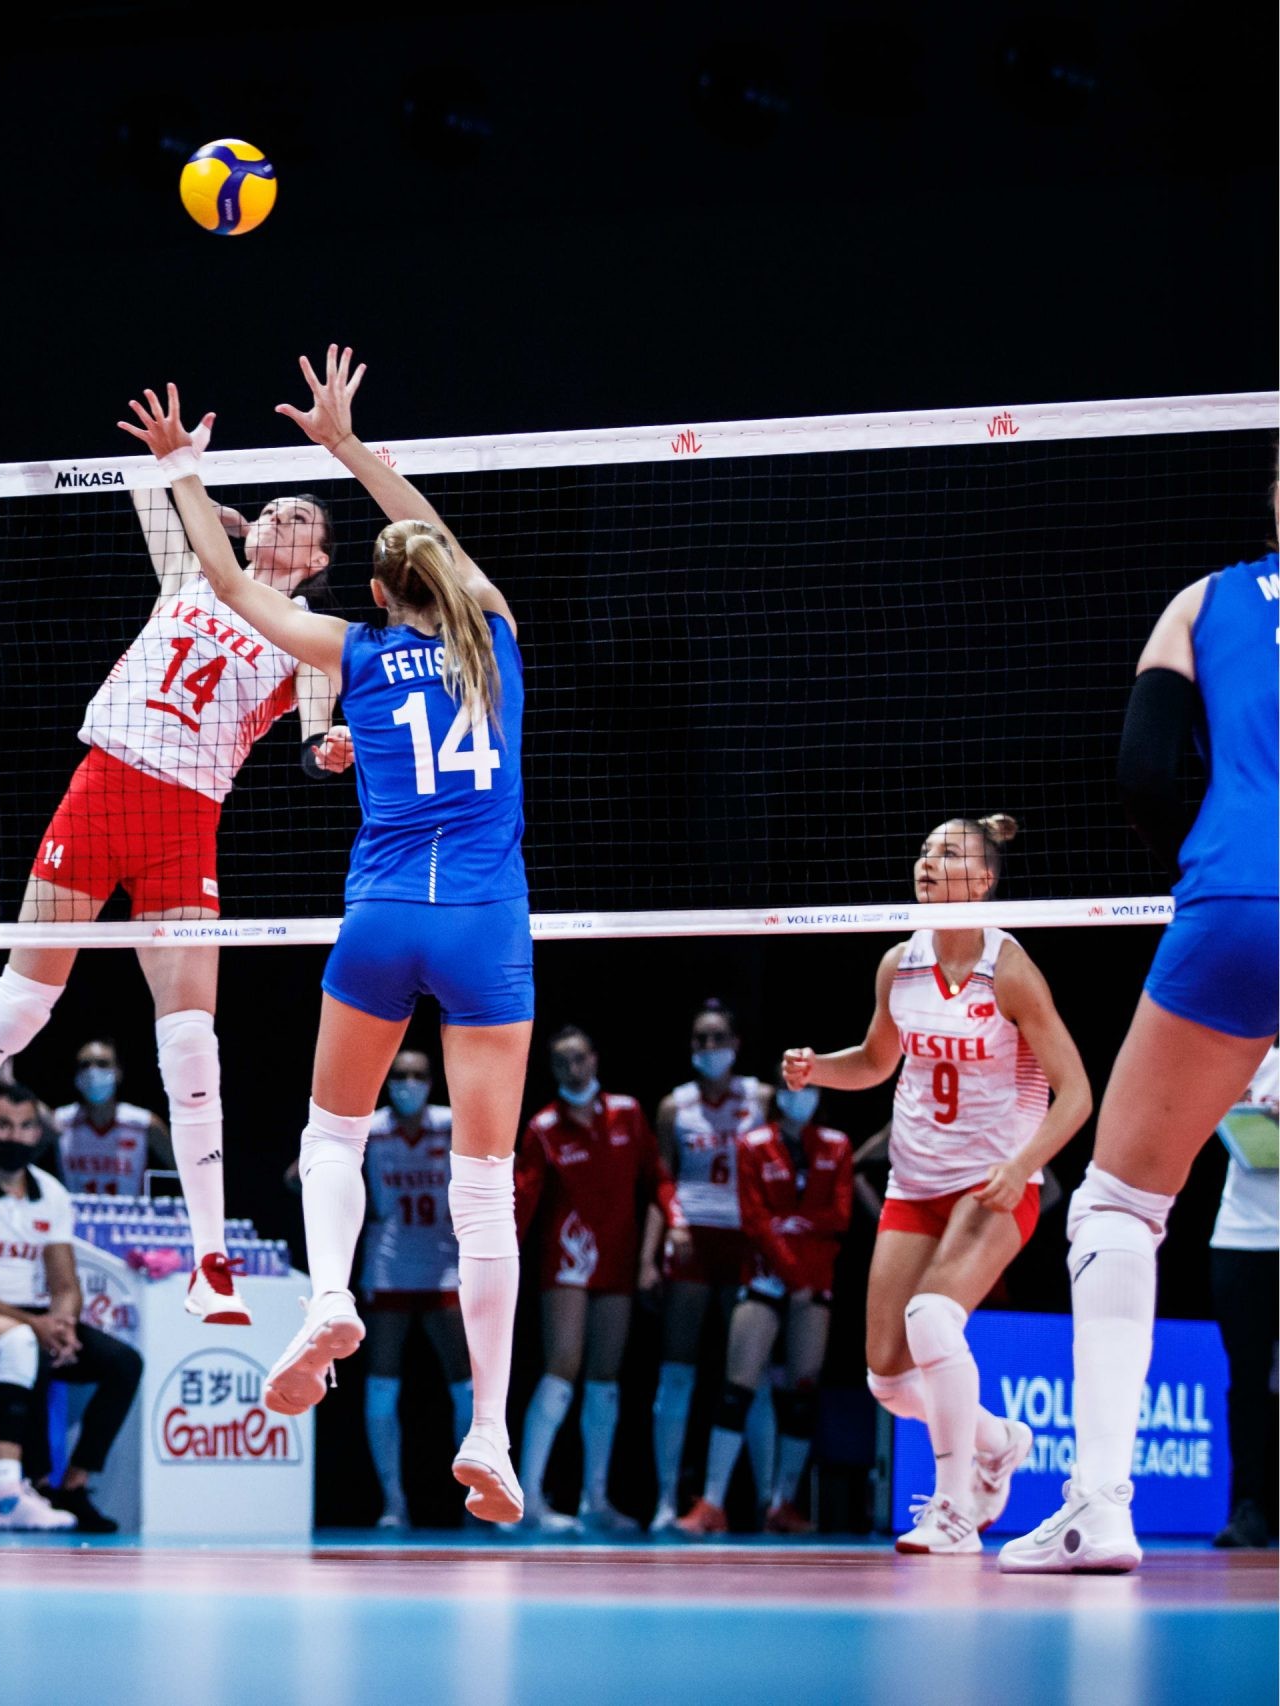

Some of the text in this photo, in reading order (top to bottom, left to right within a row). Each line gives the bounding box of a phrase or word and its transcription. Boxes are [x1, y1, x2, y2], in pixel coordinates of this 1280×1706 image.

[172, 601, 264, 671] VESTEL
[160, 637, 227, 715] 14
[381, 647, 451, 684] FETIS
[392, 690, 501, 795] 14
[44, 840, 64, 869] 14
[787, 914, 859, 924] VOLLEYBALL
[1112, 905, 1174, 916] VOLLEYBA
[173, 928, 240, 937] VOLLEYBALL
[900, 1032, 994, 1062] VESTEL
[933, 1062, 959, 1125] 9
[181, 1369, 260, 1405] 百岁山
[1000, 1376, 1212, 1432] VOLBALL
[1131, 1436, 1211, 1478] EAGUE
